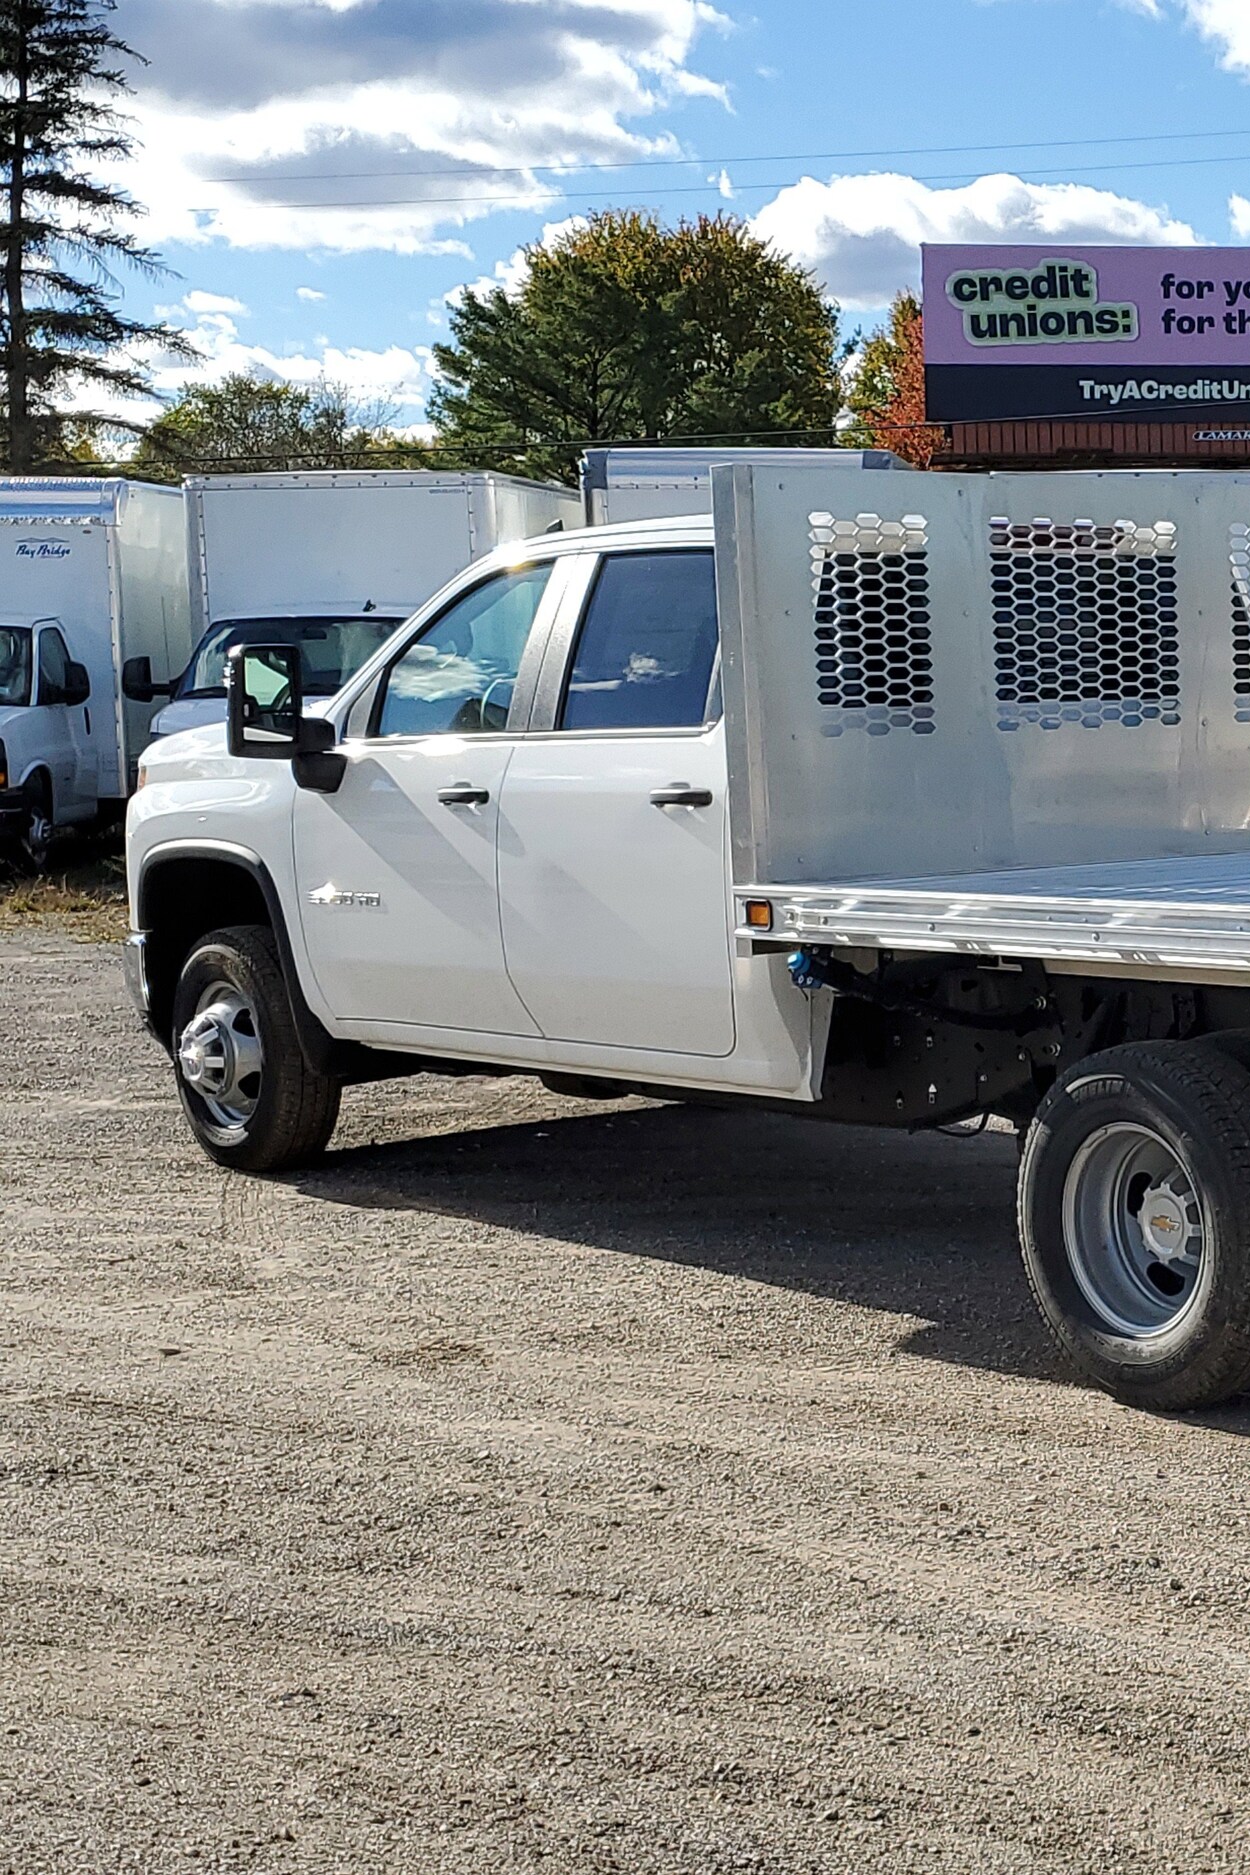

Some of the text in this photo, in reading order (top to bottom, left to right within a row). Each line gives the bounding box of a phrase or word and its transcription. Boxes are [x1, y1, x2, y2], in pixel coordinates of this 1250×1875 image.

[953, 266, 1090, 301] credit
[1161, 273, 1214, 299] for
[970, 304, 1131, 338] unions:
[1161, 308, 1215, 334] for
